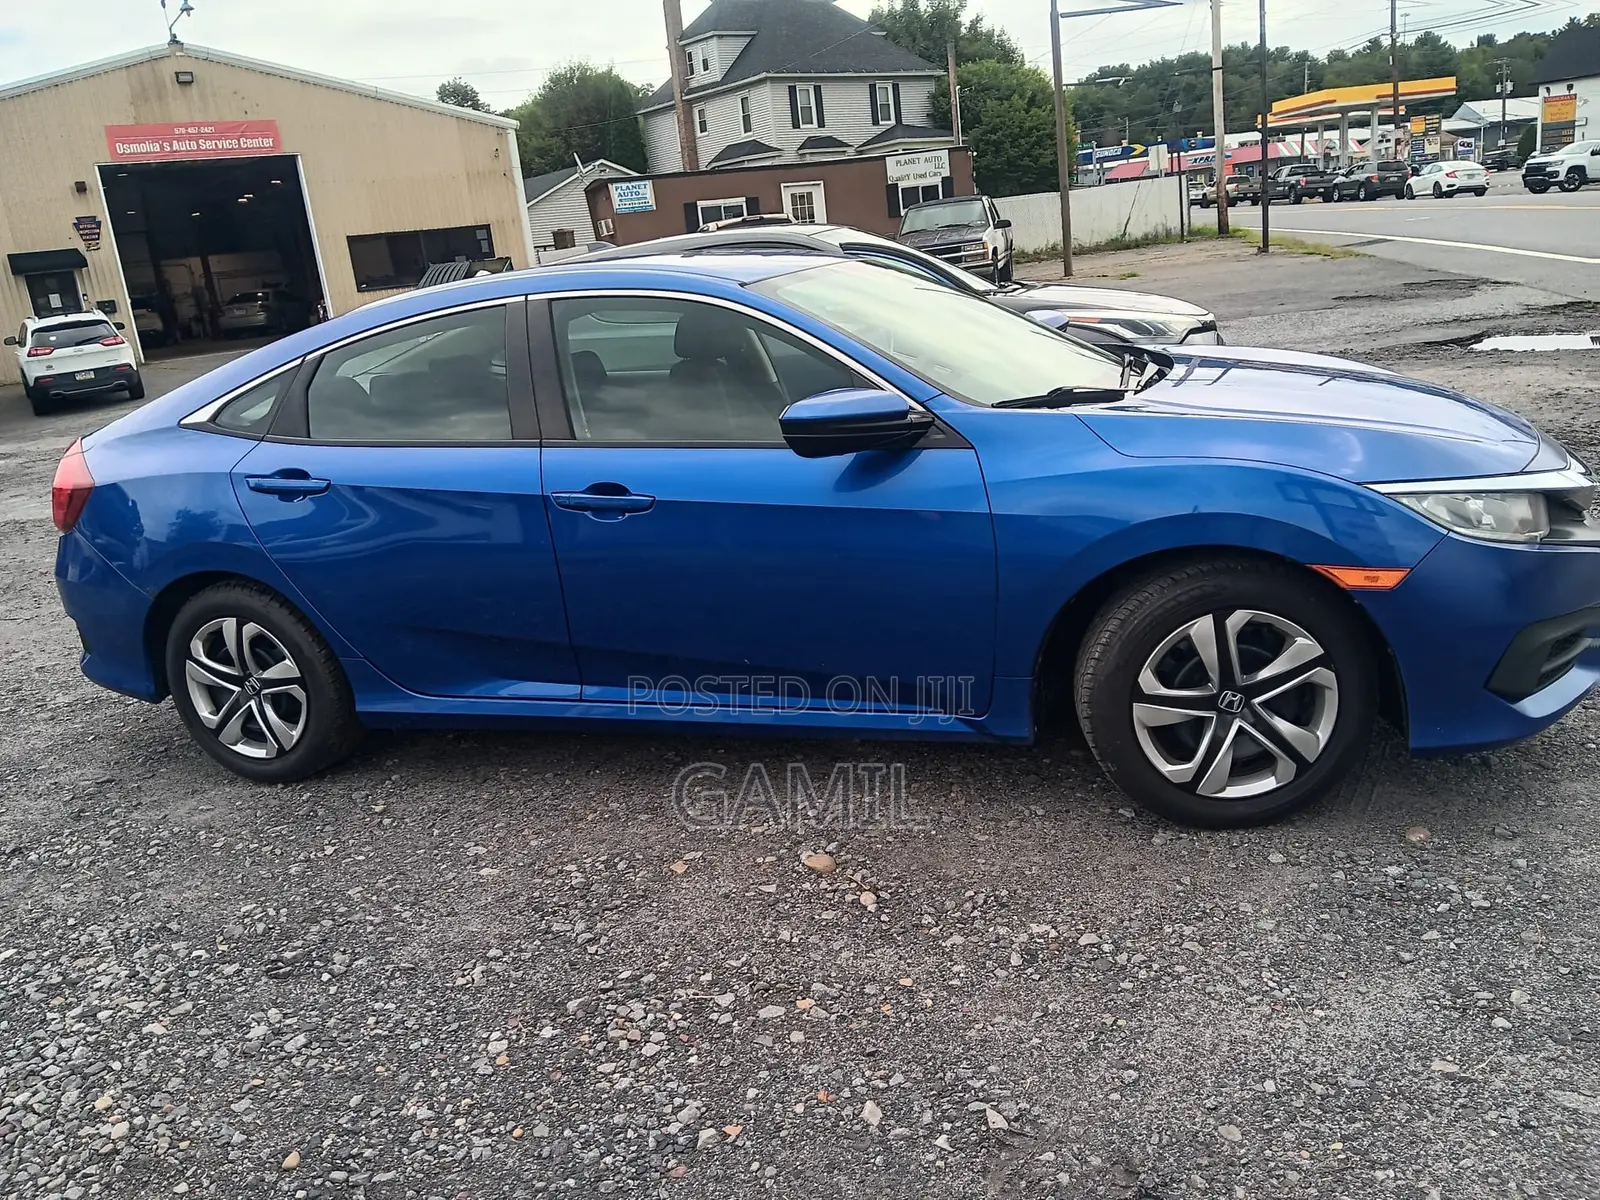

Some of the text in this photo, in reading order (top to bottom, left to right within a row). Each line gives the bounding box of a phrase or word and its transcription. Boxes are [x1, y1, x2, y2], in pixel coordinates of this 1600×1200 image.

[115, 136, 274, 154] Osmolia's Auto Service Center
[1095, 147, 1122, 159] SUNOCO
[895, 155, 943, 167] PLANET AUTO
[934, 161, 946, 170] LLC
[614, 183, 648, 192] PLANET
[617, 190, 640, 198] AUTO
